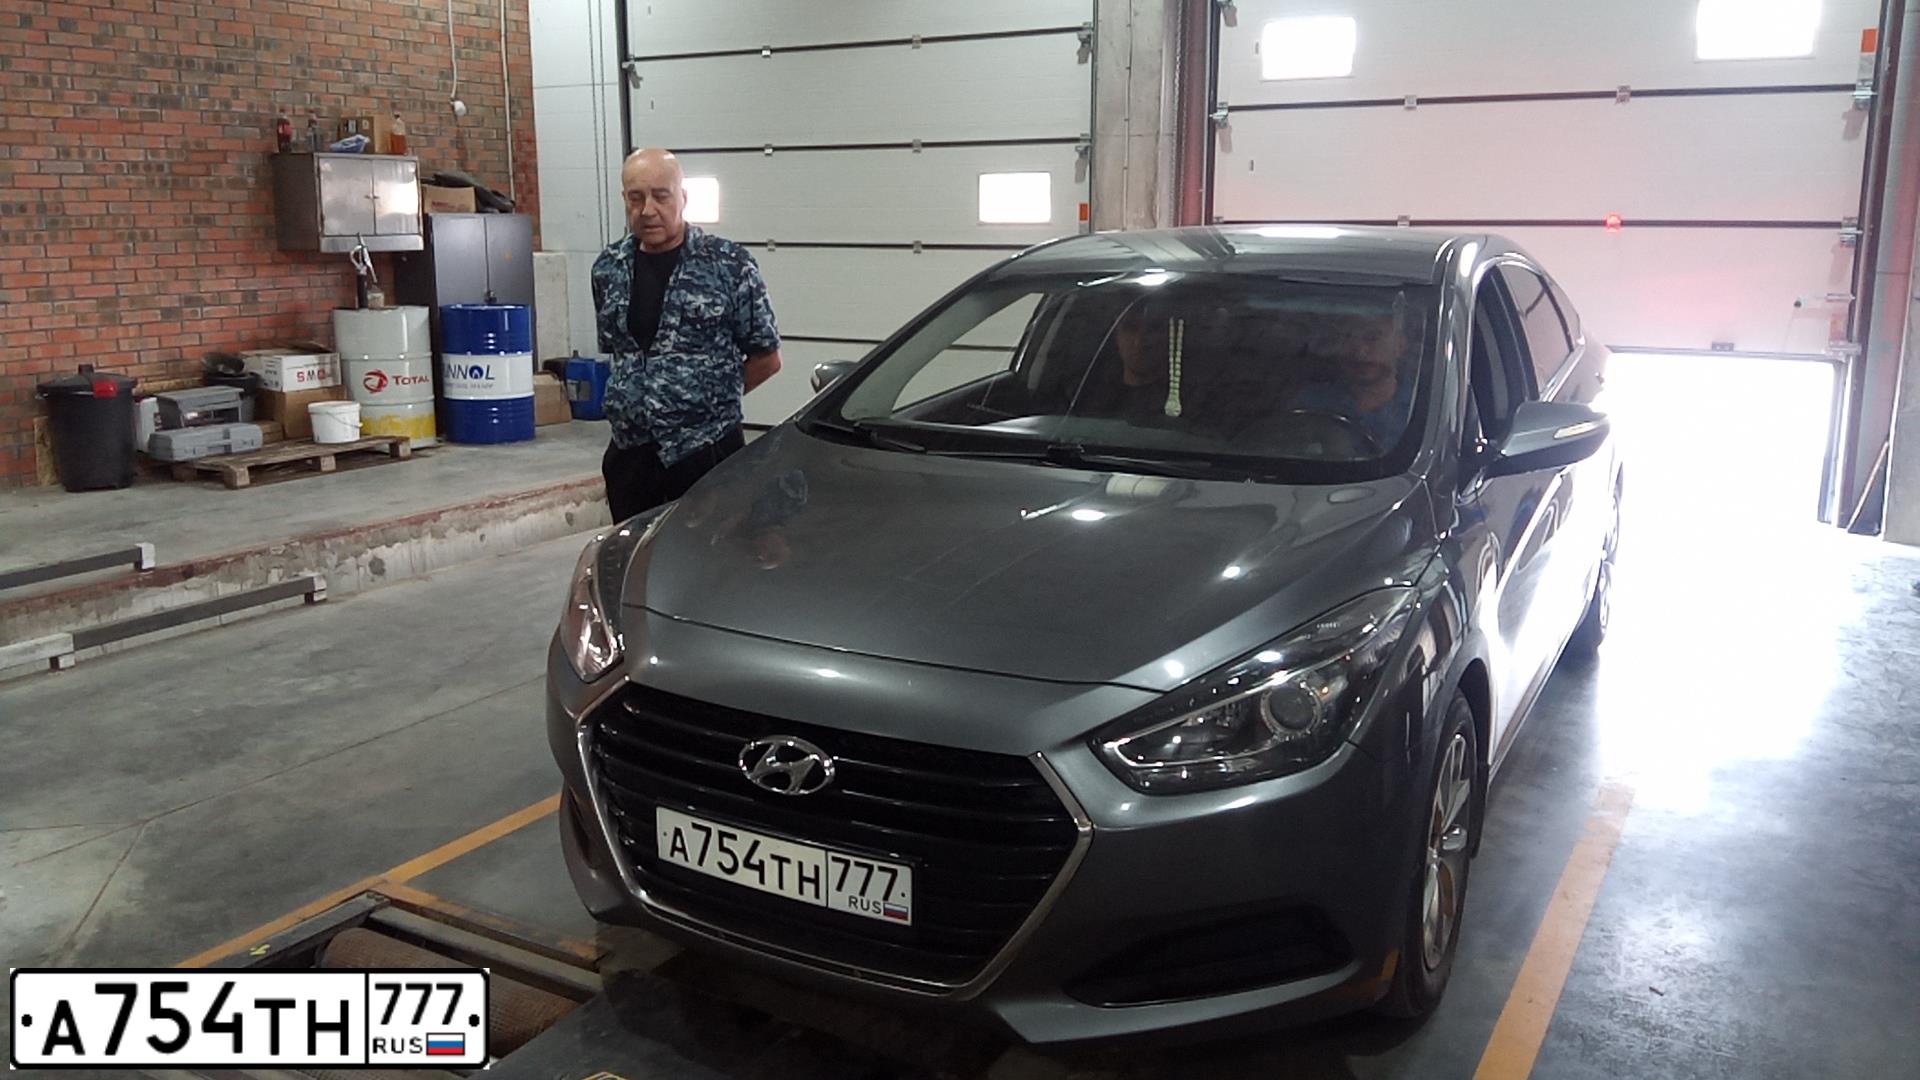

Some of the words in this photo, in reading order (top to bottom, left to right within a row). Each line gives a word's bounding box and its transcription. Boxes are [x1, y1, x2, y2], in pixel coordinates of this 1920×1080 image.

[392, 375, 430, 386] TOTAL
[831, 856, 899, 901] 777
[848, 896, 883, 915] RUS
